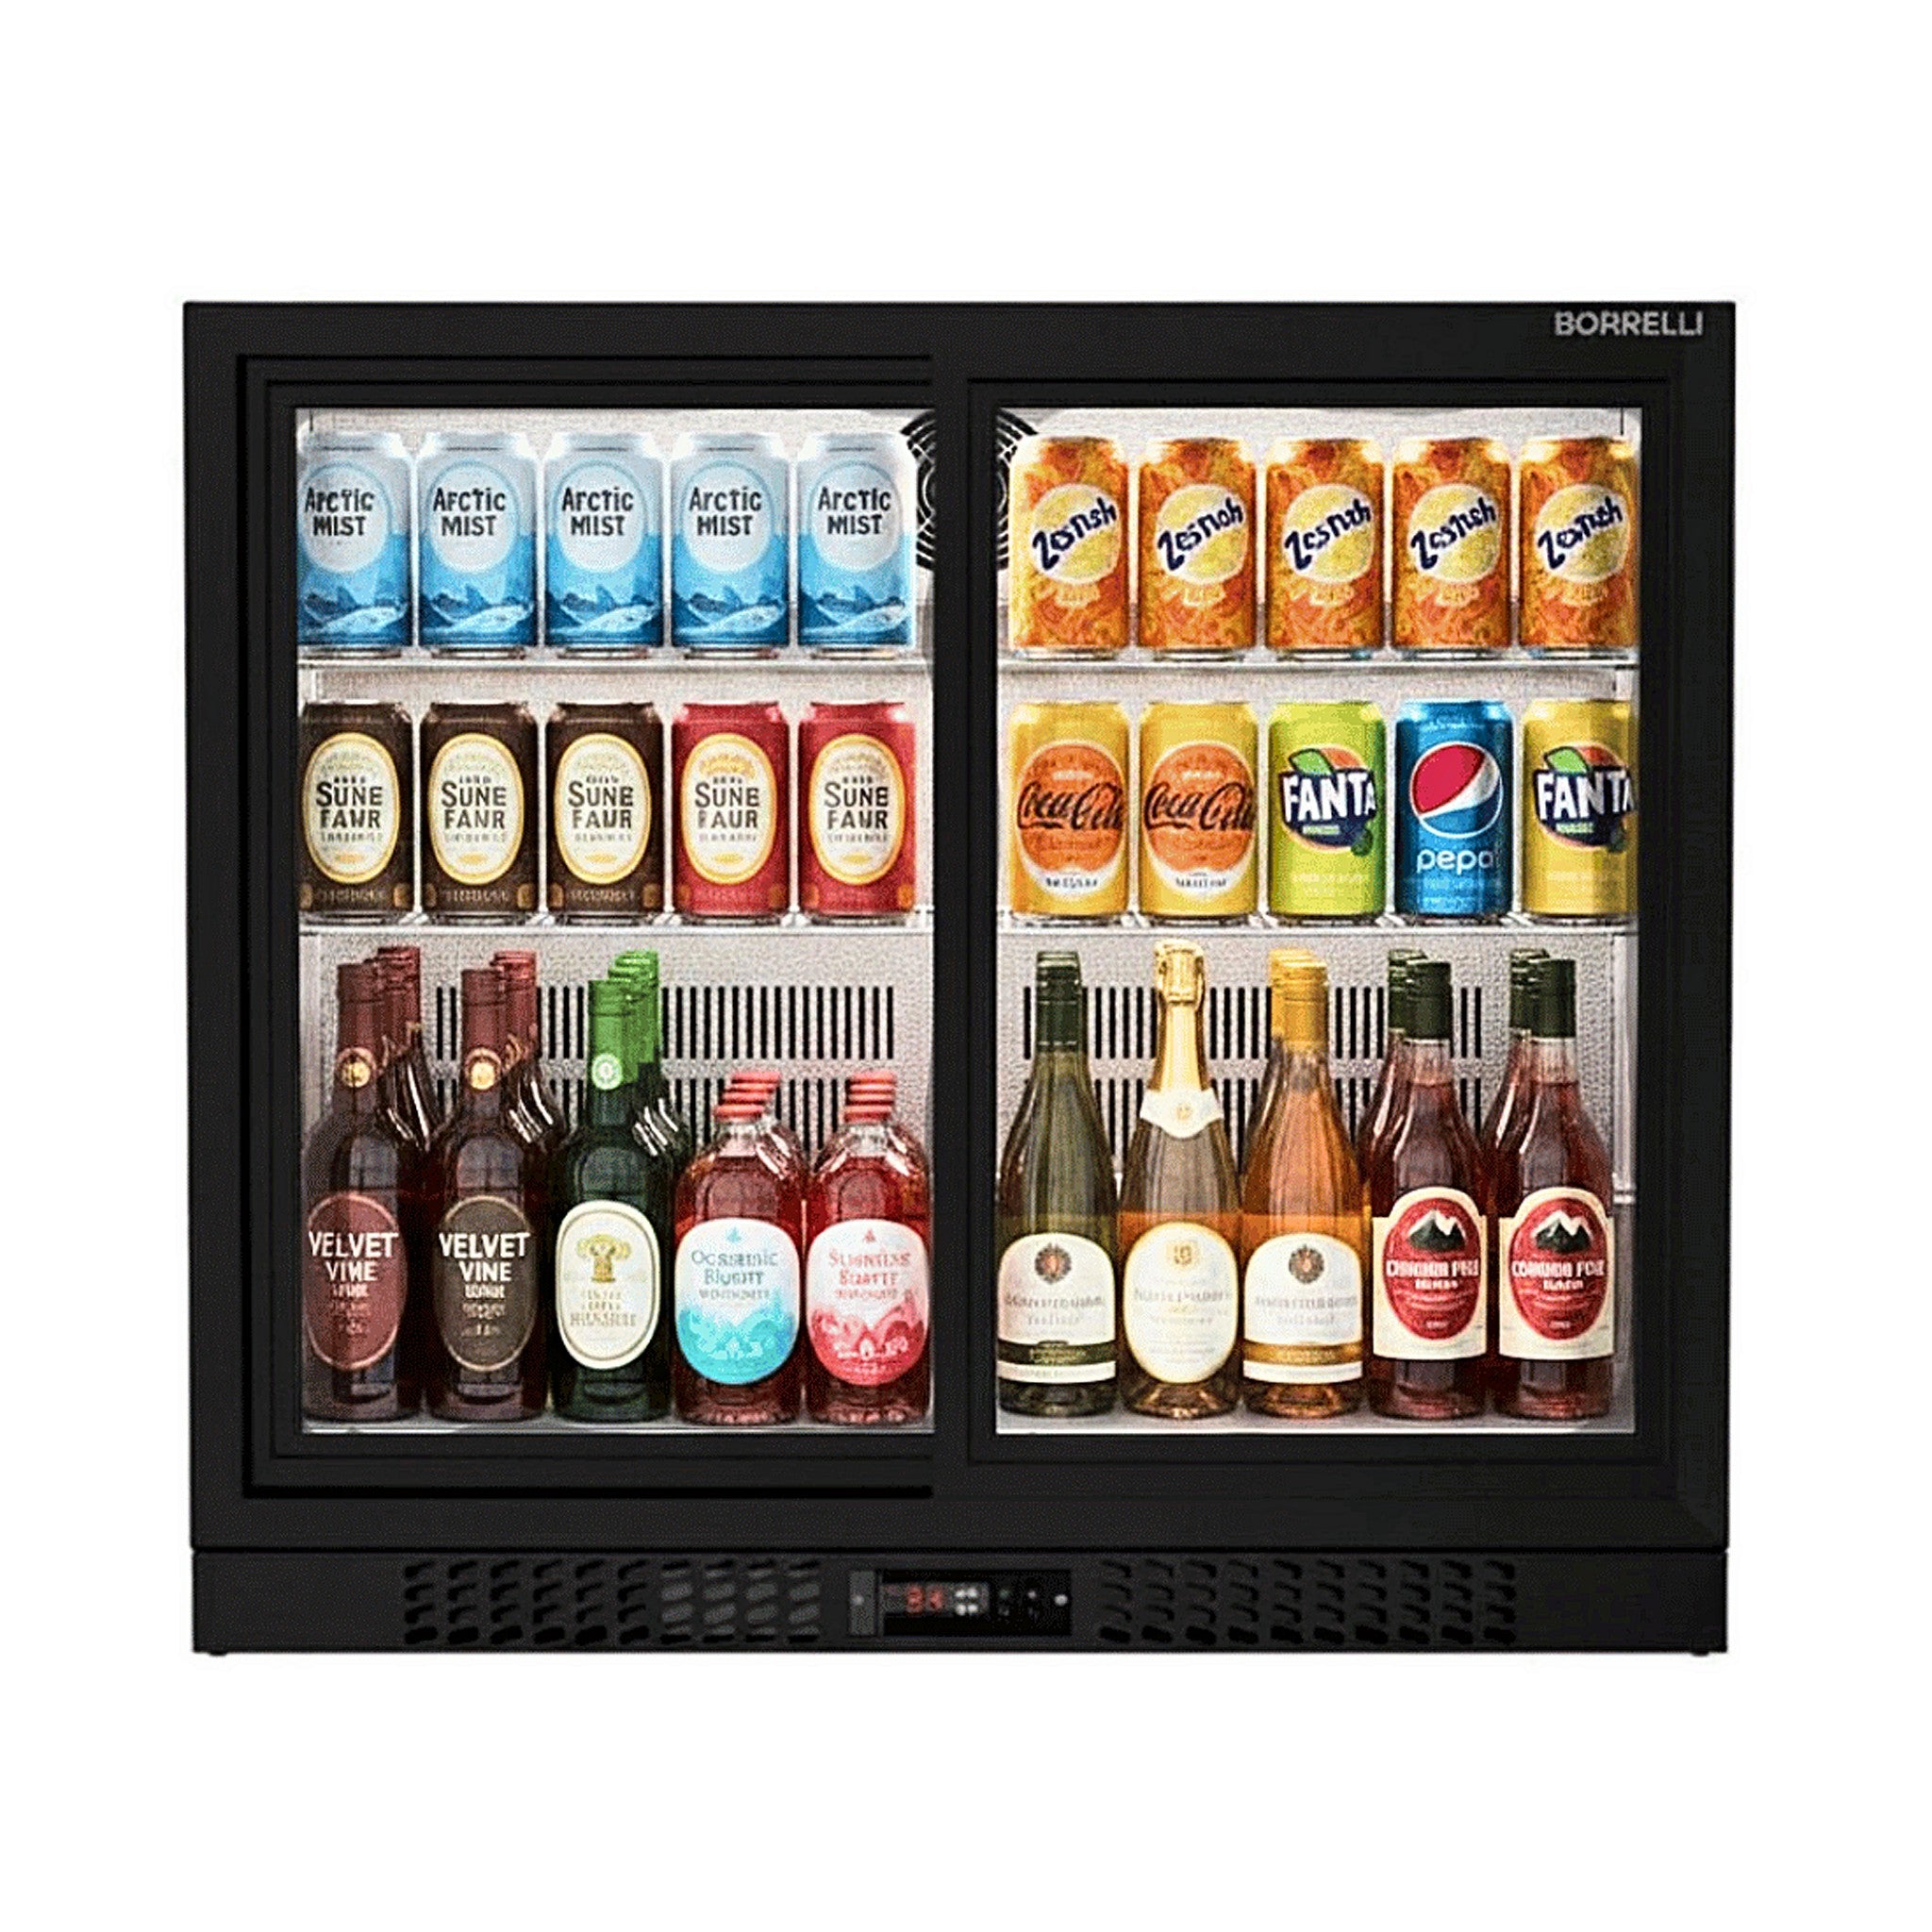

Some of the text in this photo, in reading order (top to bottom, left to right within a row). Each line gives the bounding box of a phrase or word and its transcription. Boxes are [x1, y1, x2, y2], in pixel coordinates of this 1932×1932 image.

[1555, 310, 1704, 336] BORRELLI
[1282, 773, 1376, 823] FANTA
[308, 1230, 400, 1258] VELVET
[438, 1231, 531, 1259] VELVET
[458, 1260, 512, 1282] VINE
